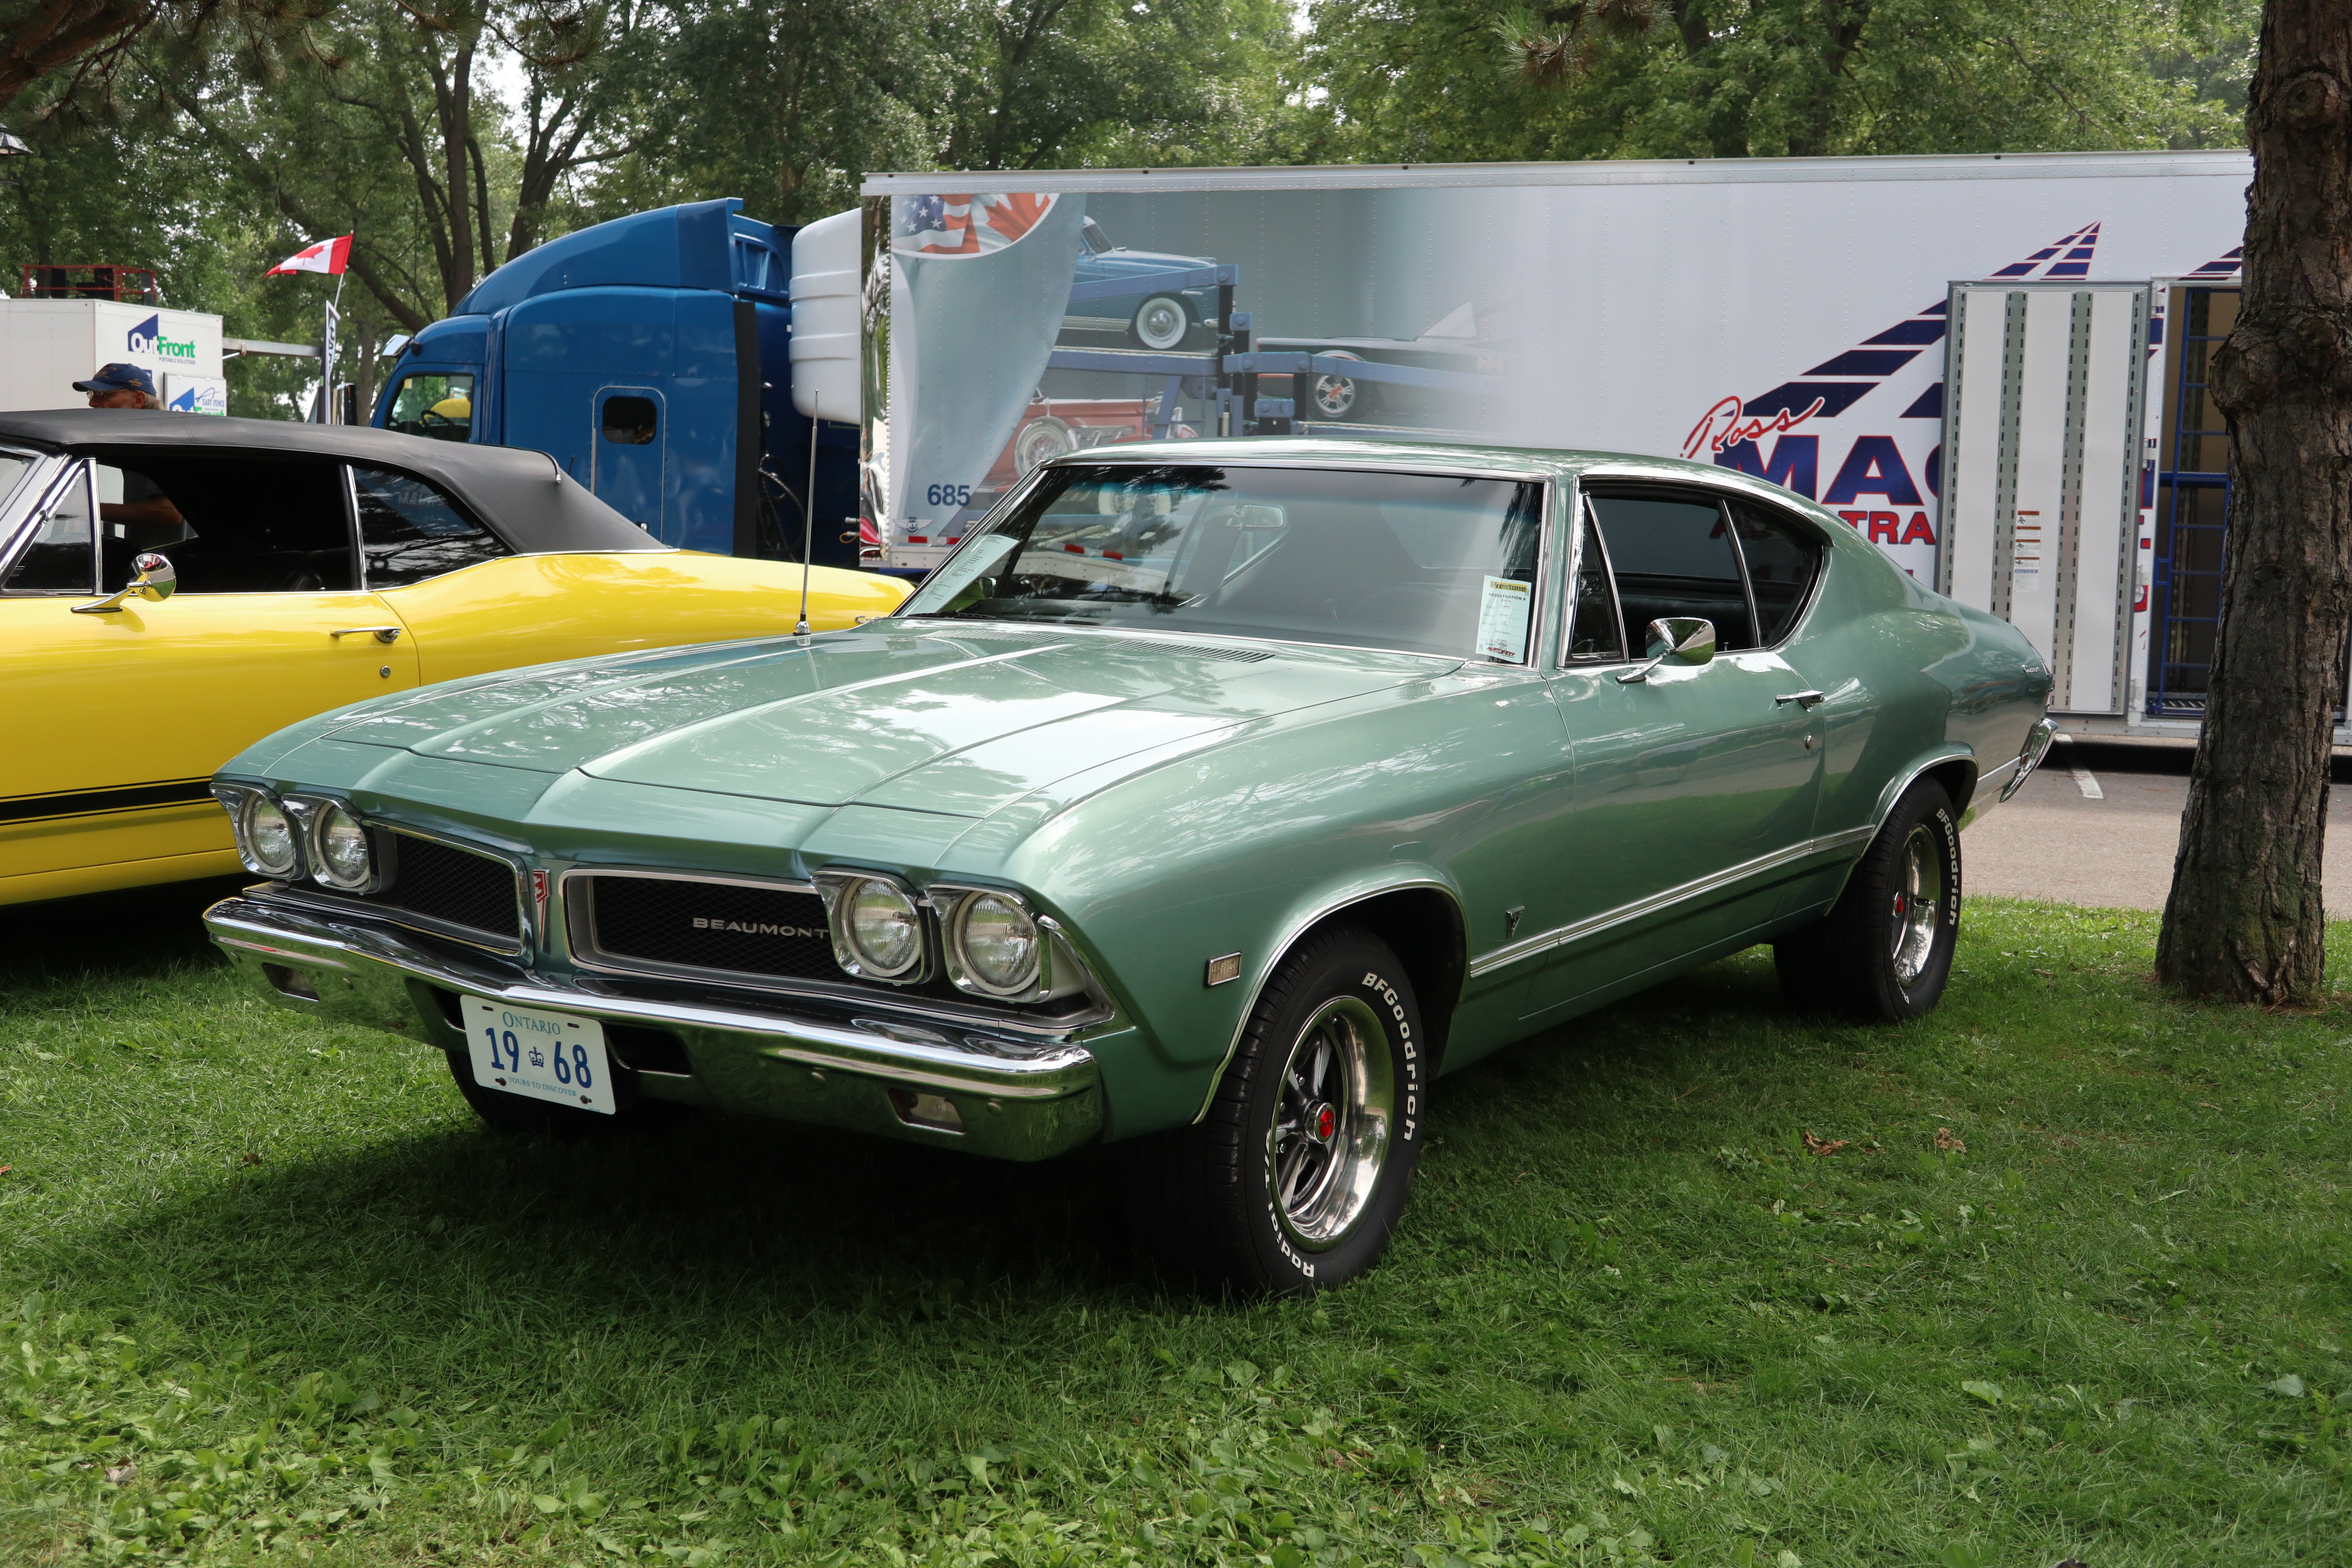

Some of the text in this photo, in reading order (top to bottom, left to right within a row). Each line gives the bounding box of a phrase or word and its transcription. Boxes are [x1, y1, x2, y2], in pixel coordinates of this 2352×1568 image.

[131, 332, 196, 358] OutFront
[1680, 396, 1824, 458] Ross
[927, 484, 971, 506] 685
[1491, 581, 1526, 592] Prestone
[1936, 808, 1959, 926] BFGoodrich
[693, 917, 829, 939] BEAUMONT
[502, 1012, 561, 1035] ONTARIO
[485, 1027, 592, 1089] 19 68
[1362, 972, 1418, 1142] BFGoodrich
[508, 1076, 530, 1087] YOURS
[531, 1081, 541, 1090] TO
[543, 1084, 577, 1097] DISCOVER
[1268, 1201, 1315, 1278] Radial
